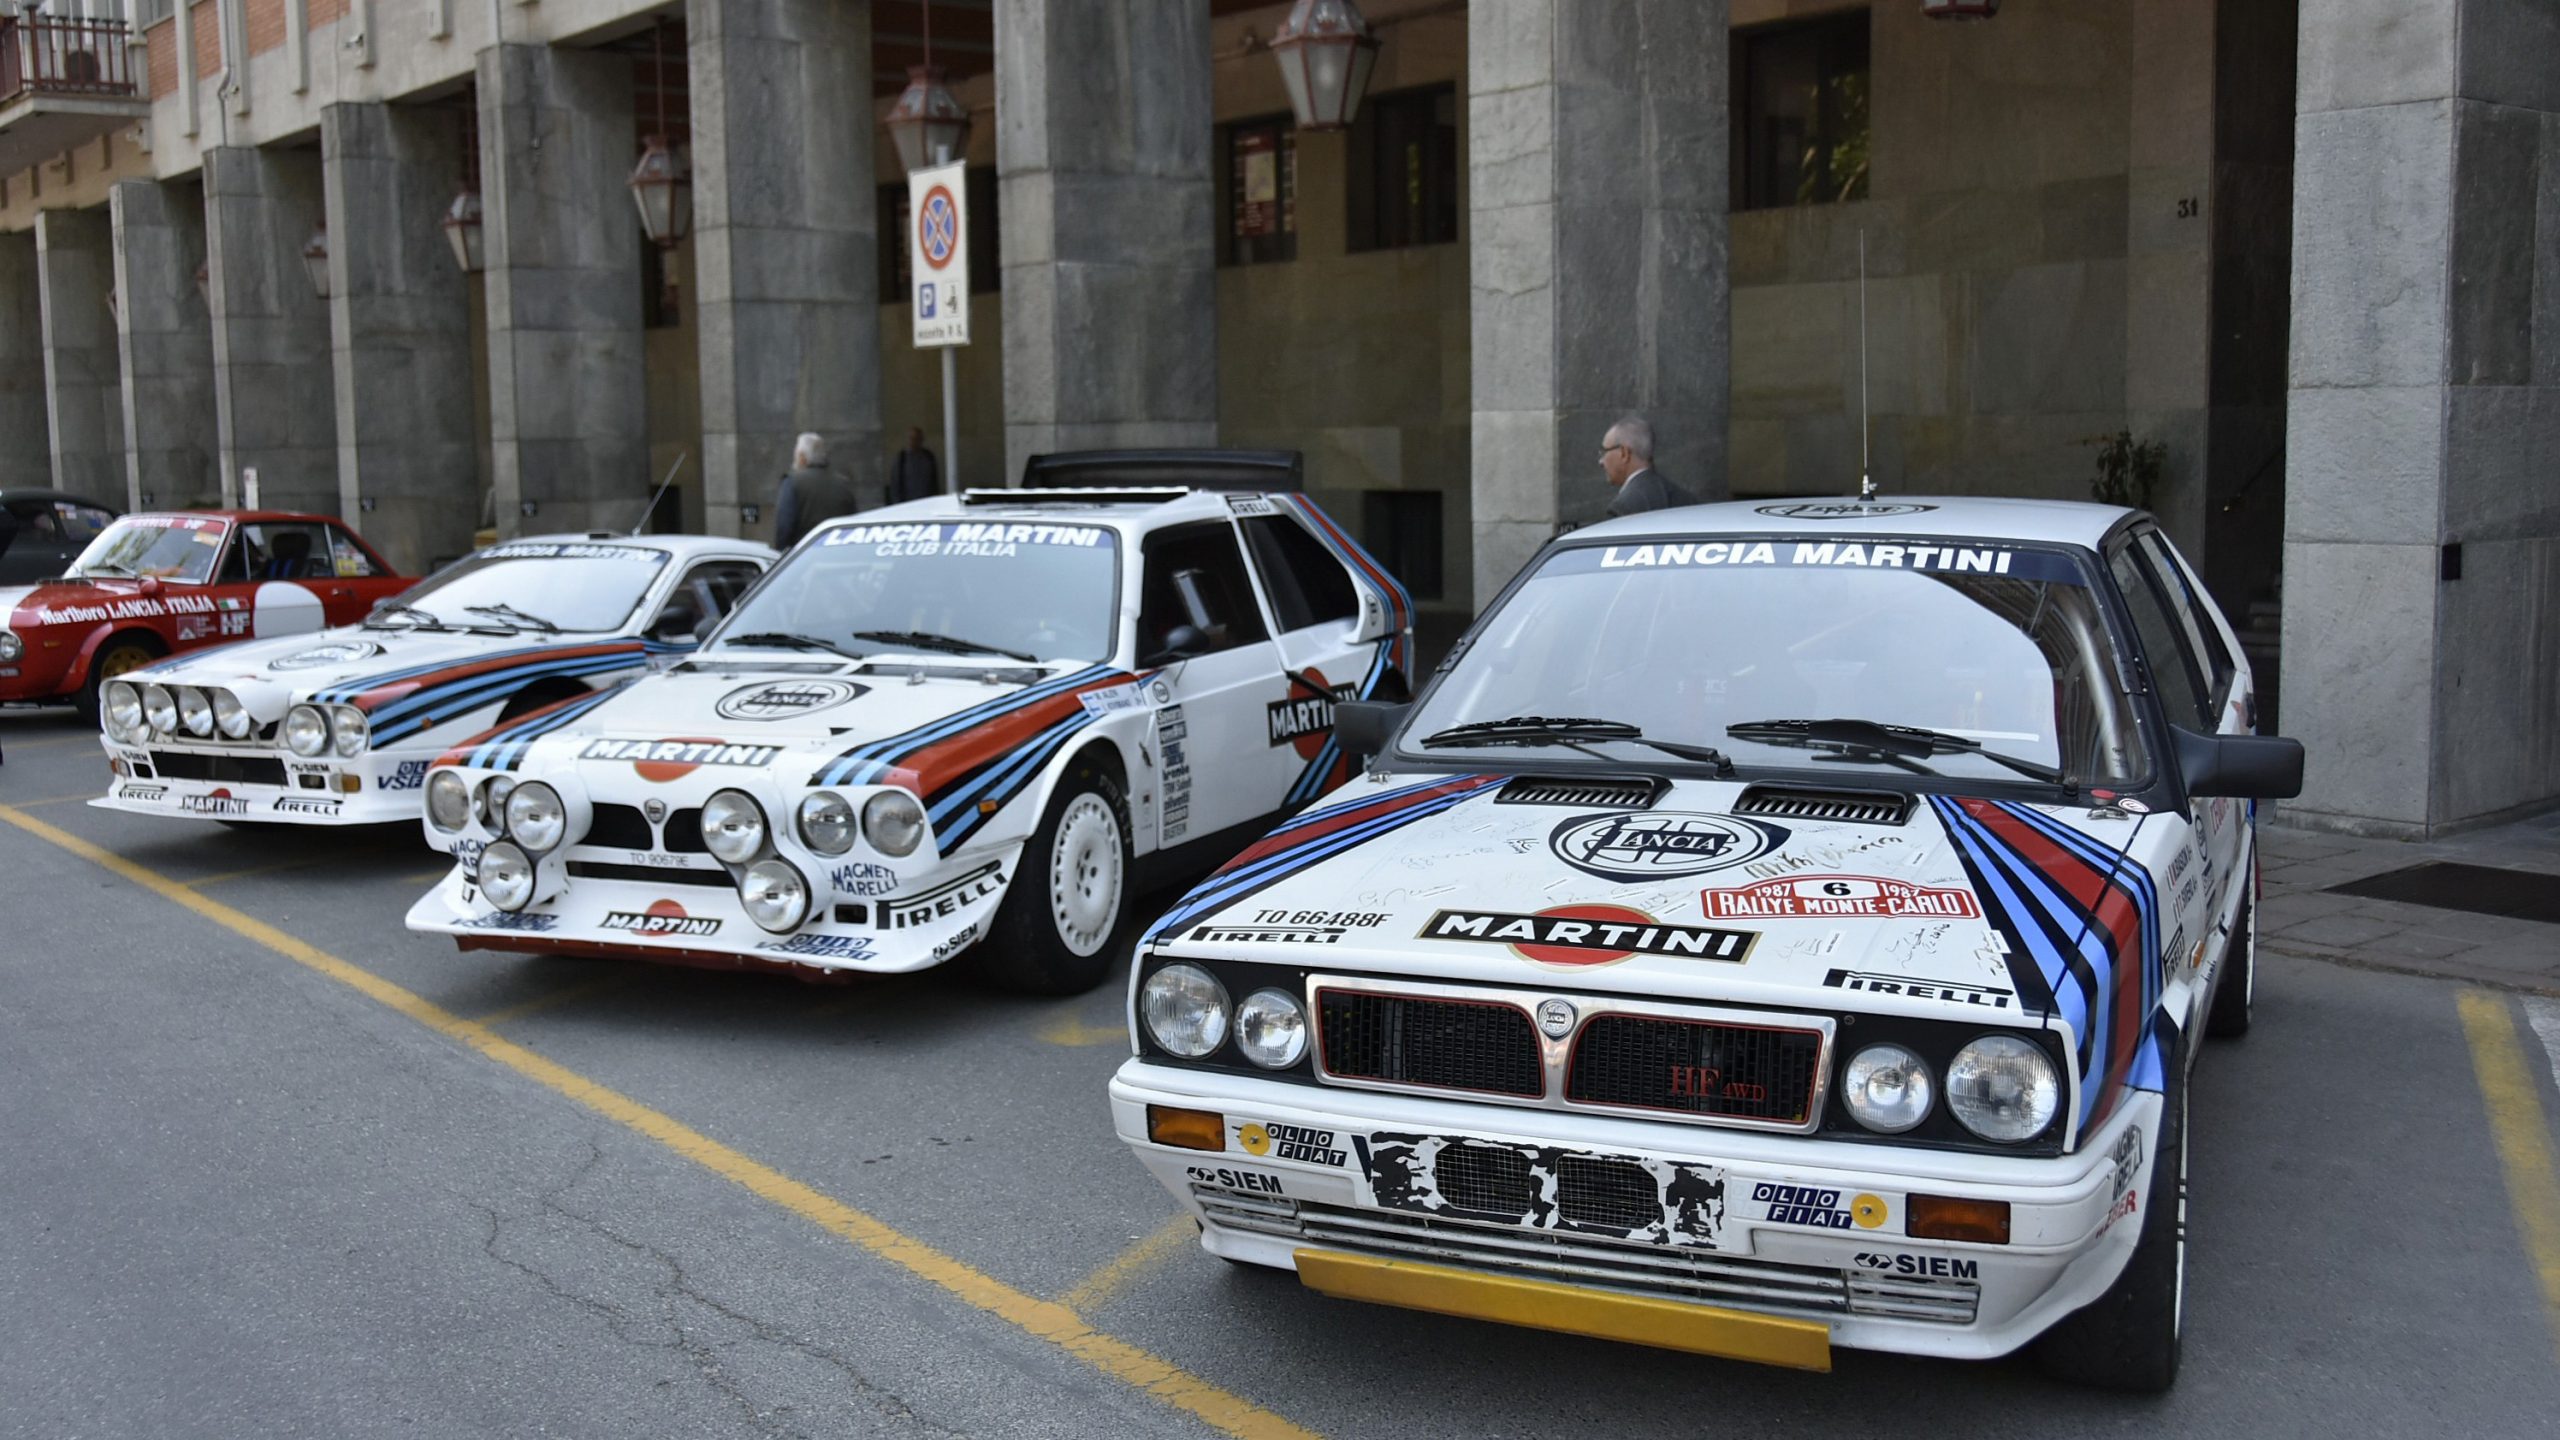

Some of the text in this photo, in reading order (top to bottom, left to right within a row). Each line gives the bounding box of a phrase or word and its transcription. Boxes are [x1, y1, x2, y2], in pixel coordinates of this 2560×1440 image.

[2178, 197, 2198, 219] 31
[823, 524, 1101, 547] LANCIA MARTINI
[875, 541, 1016, 557] CLUB ITALIA
[1601, 543, 2012, 574] LANCIA MARTINI
[37, 604, 107, 626] Marlboro
[585, 740, 773, 766] MARTINI
[181, 795, 249, 814] MARTINI
[273, 797, 344, 816] PIRELLI
[1603, 829, 1718, 850] LANCIA
[831, 863, 898, 884] MAGNETI
[874, 859, 1009, 931] PIRELLI
[1754, 881, 1921, 898] 1987 6 1987
[1719, 892, 1963, 916] RALLYE MONTE-CARLO
[605, 914, 720, 937] MARTINI
[1253, 909, 1394, 929] TO 66488F
[949, 922, 979, 950] SIEM
[1188, 926, 1348, 944] PIRELLI
[1436, 915, 1740, 956] MARTINI
[1822, 968, 2015, 1008] PIRELLI
[1669, 1064, 1767, 1103] HF 4WD
[1266, 1124, 1332, 1147] OLIO
[1279, 1143, 1346, 1166] FIAT
[1216, 1168, 1284, 1195] SIEM
[1754, 1185, 1838, 1207] OLIO
[1769, 1205, 1851, 1229] FIAT
[1895, 1254, 1979, 1280] SIEM
